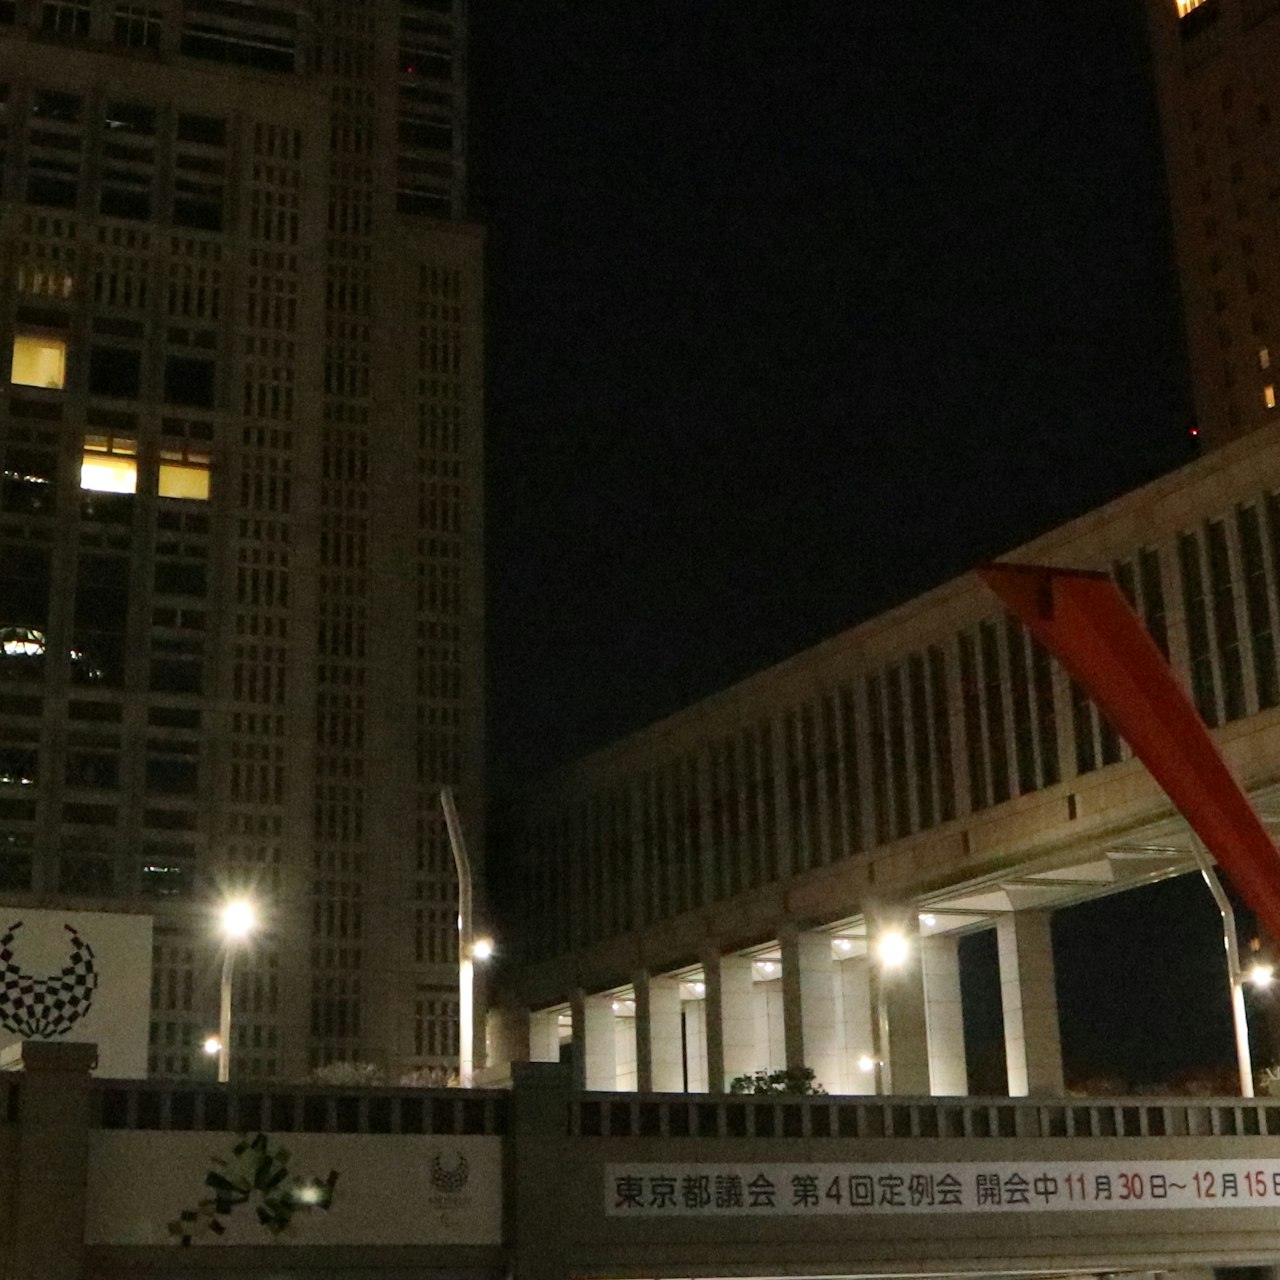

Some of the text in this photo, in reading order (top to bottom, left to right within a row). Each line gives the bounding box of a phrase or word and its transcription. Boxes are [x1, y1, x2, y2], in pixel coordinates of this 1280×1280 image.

[614, 1173, 776, 1209] 東京都議会
[791, 1173, 963, 1208] 第4回定例会
